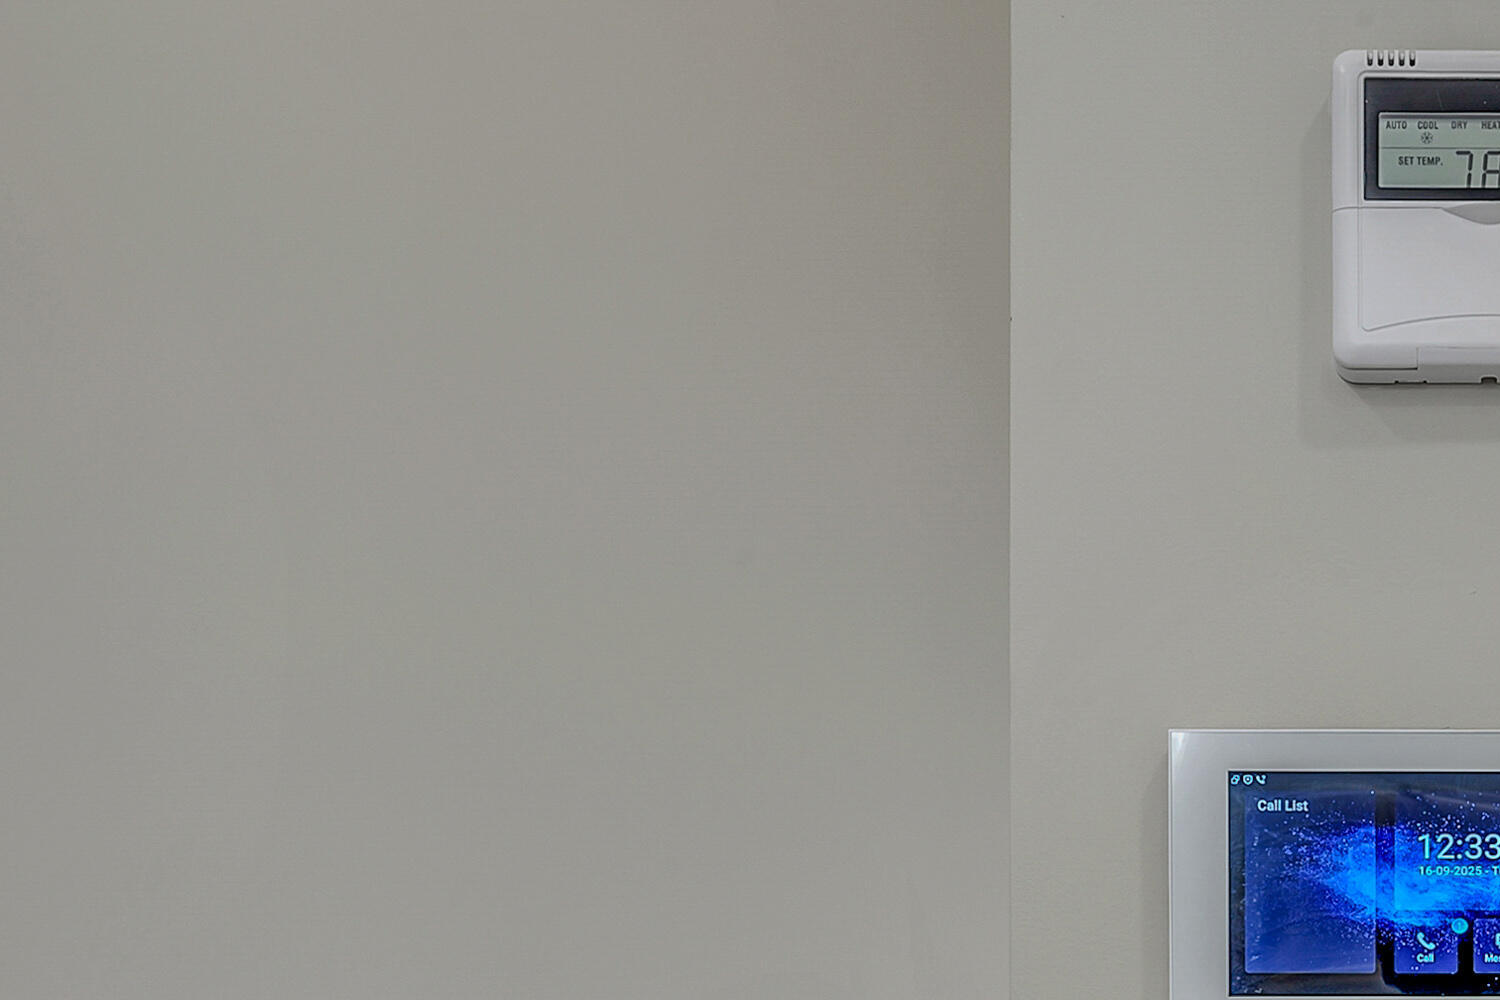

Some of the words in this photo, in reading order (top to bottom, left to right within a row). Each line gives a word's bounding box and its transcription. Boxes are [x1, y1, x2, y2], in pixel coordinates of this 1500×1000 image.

[1386, 121, 1408, 130] AUTO
[1417, 121, 1439, 130] COOL
[1451, 121, 1468, 130] DRY
[1398, 156, 1414, 166] SET
[1416, 156, 1443, 166] TEMP.
[1257, 799, 1282, 812] Call
[1284, 799, 1309, 812] List
[1419, 866, 1482, 876] 16-09-2025
[1416, 953, 1434, 963] Call
